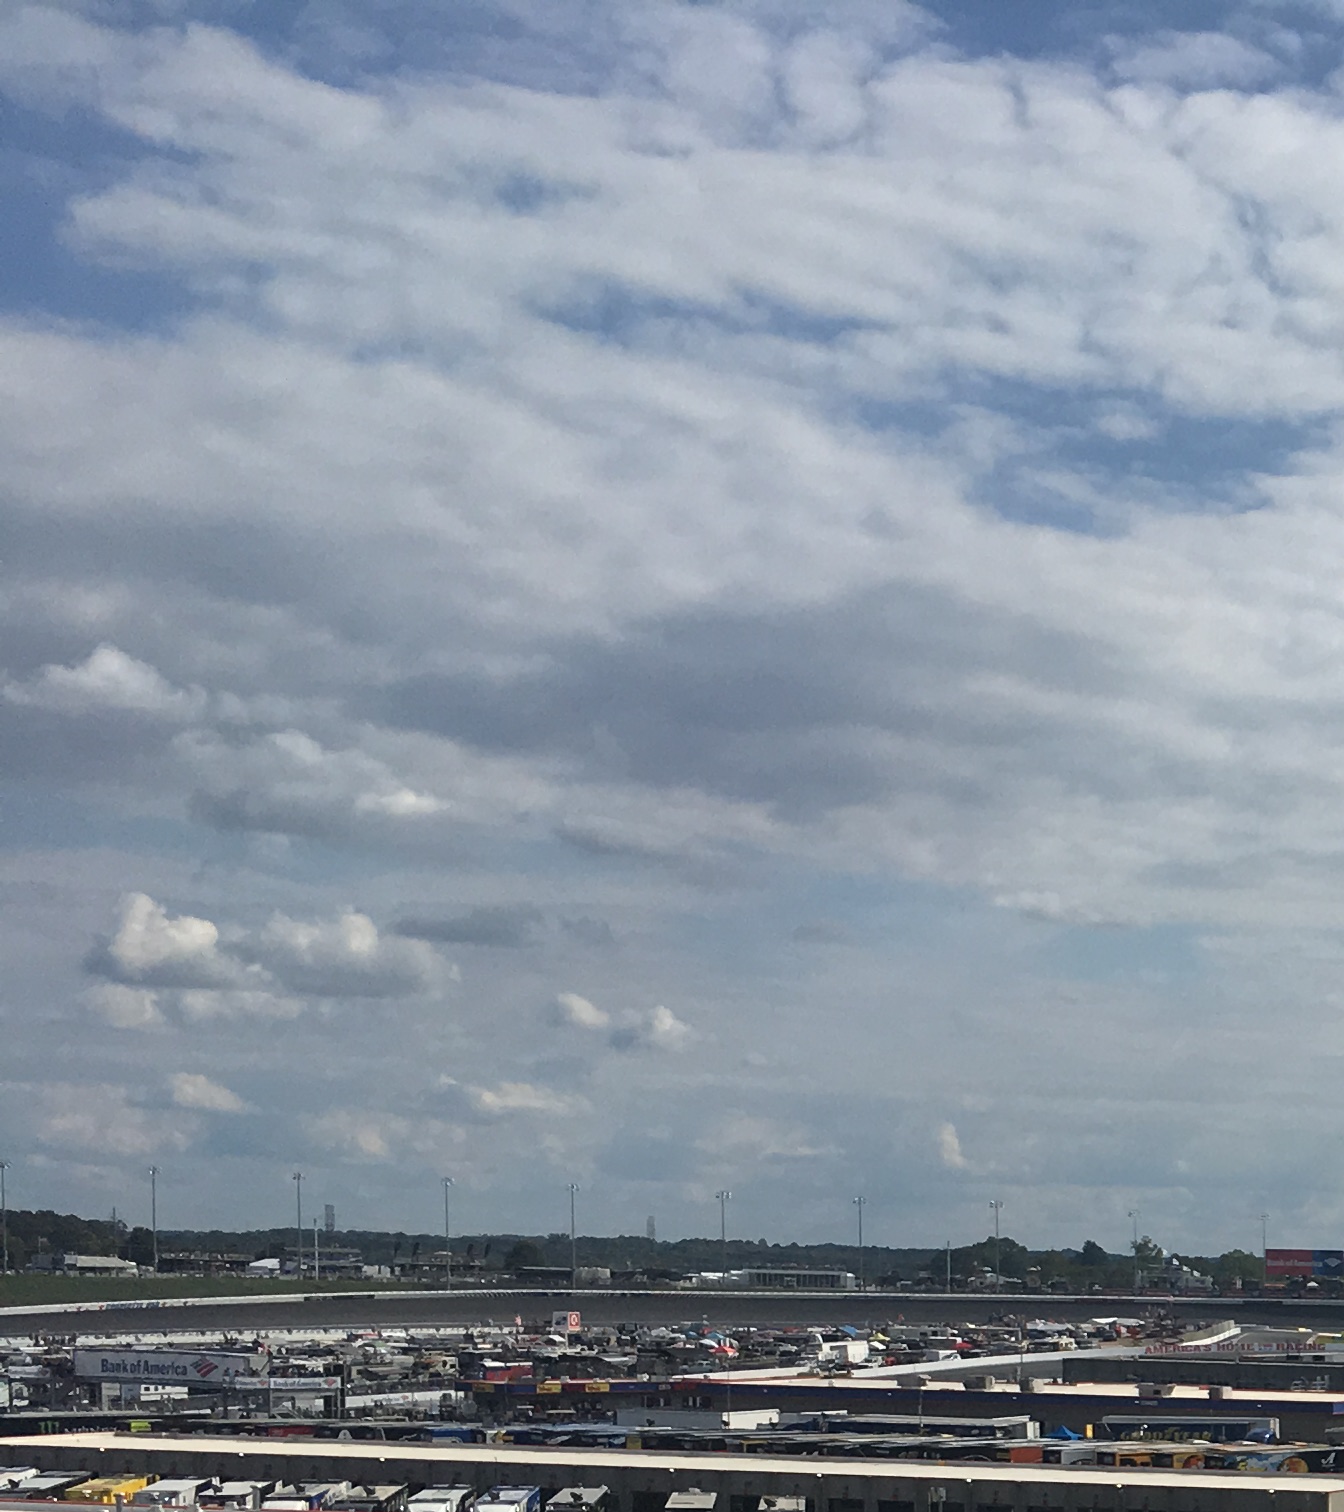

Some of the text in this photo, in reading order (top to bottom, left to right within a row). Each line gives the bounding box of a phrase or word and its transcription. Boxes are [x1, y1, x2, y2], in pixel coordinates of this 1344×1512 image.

[101, 1358, 188, 1377] Bank of America
